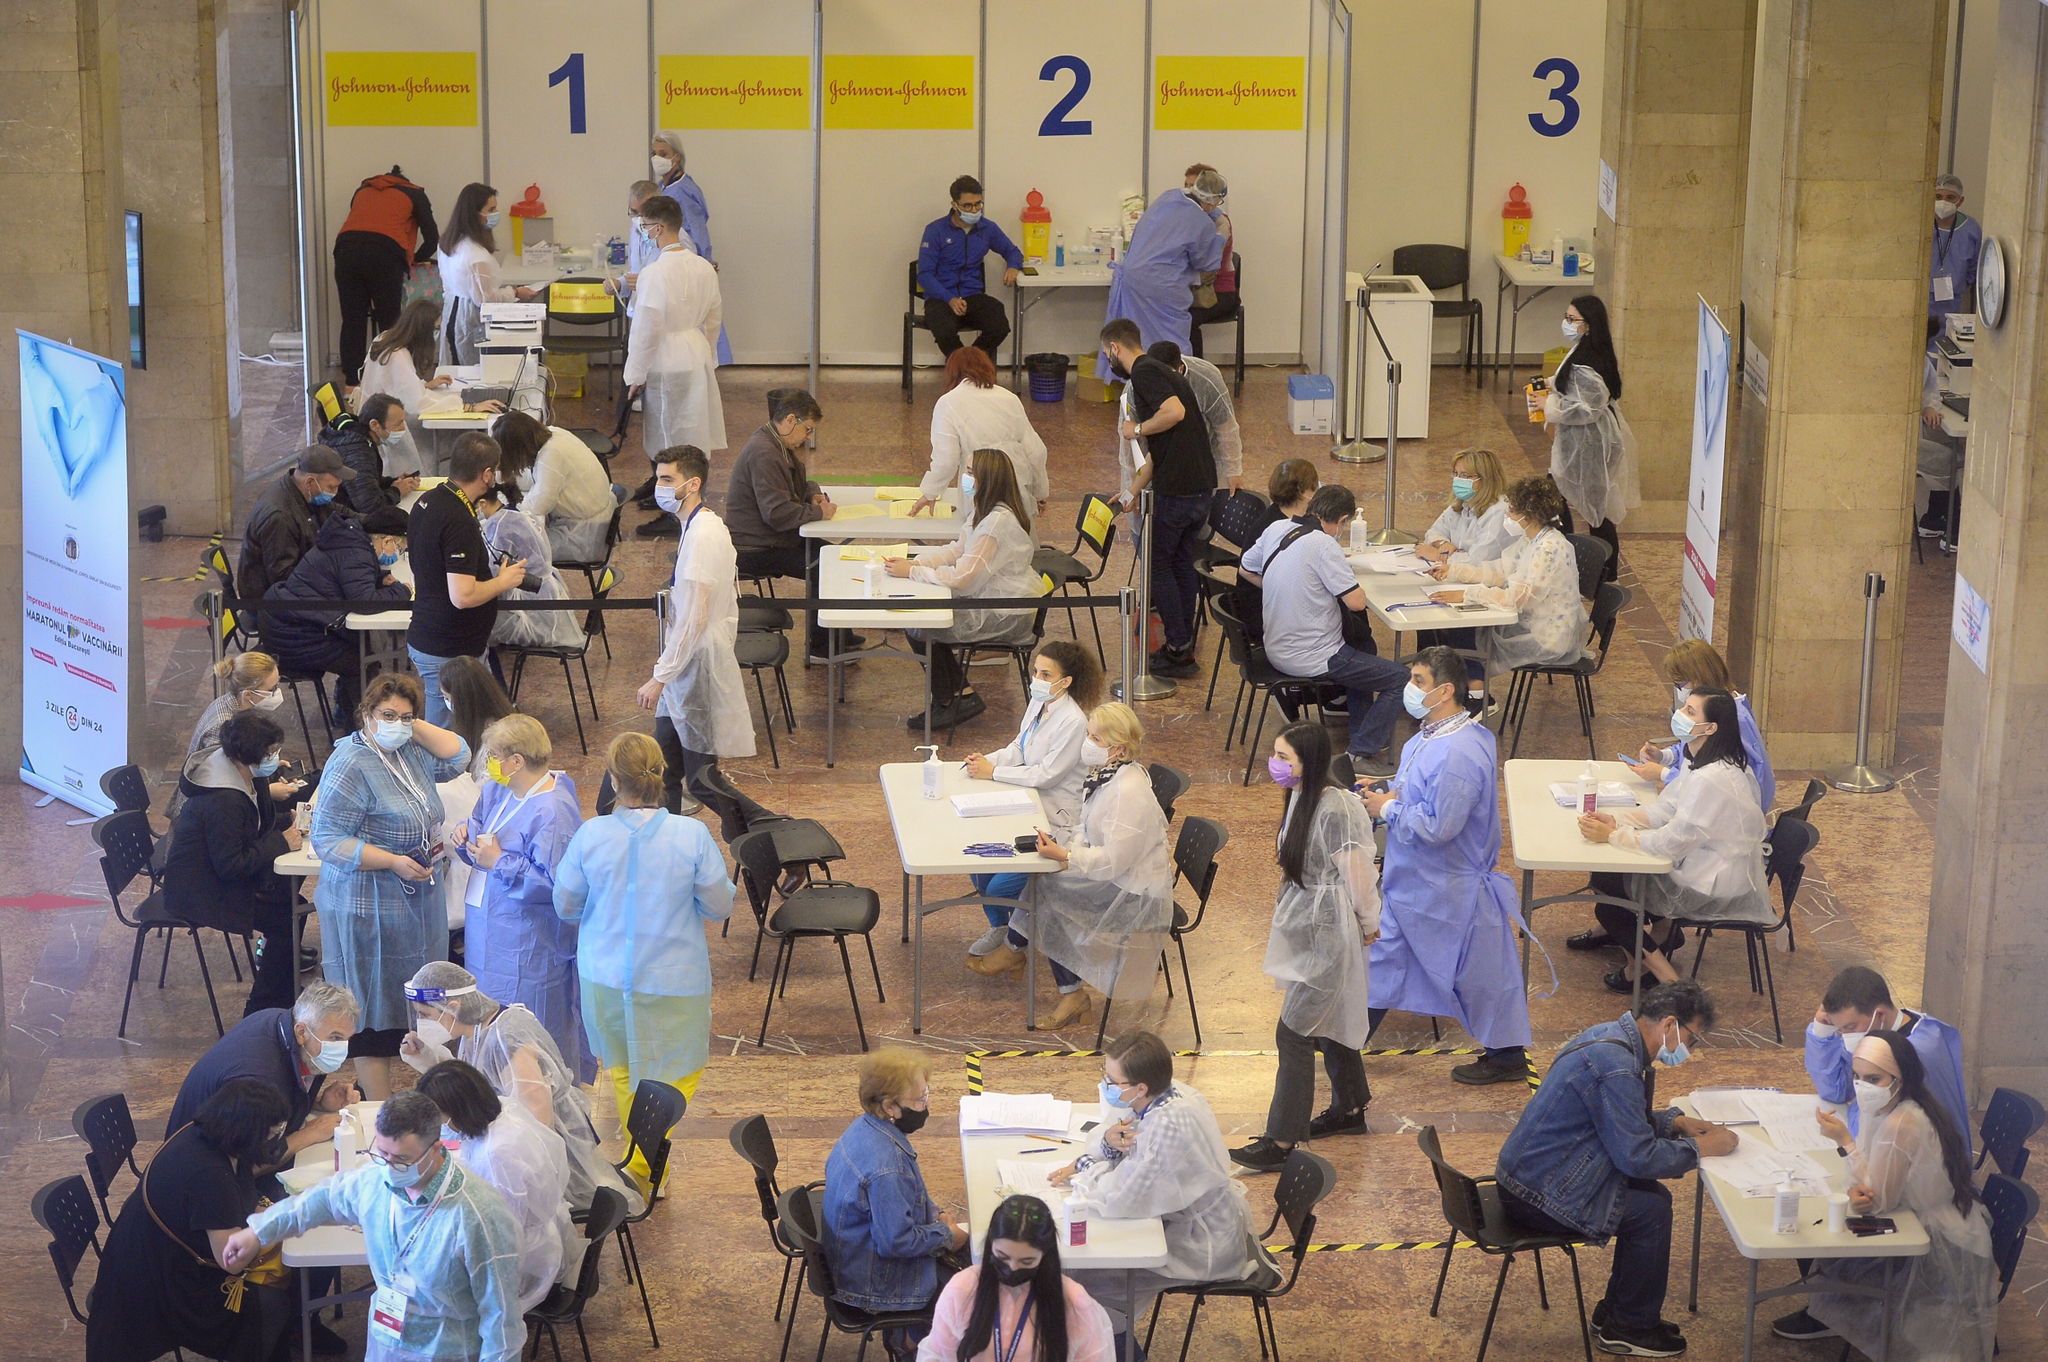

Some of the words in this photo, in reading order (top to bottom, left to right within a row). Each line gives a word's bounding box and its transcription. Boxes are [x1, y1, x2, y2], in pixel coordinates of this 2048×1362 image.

[549, 53, 586, 133] 1
[1038, 55, 1092, 136] 2
[1528, 57, 1580, 137] 3
[26, 608, 67, 635] MARATONUL
[82, 631, 123, 658] VACCINĂRII
[69, 613, 106, 633] normalitatea
[45, 700, 50, 710] 3
[50, 702, 65, 717] ZILE
[68, 711, 77, 722] 24
[81, 716, 93, 729] DIN
[94, 722, 103, 733] 24
